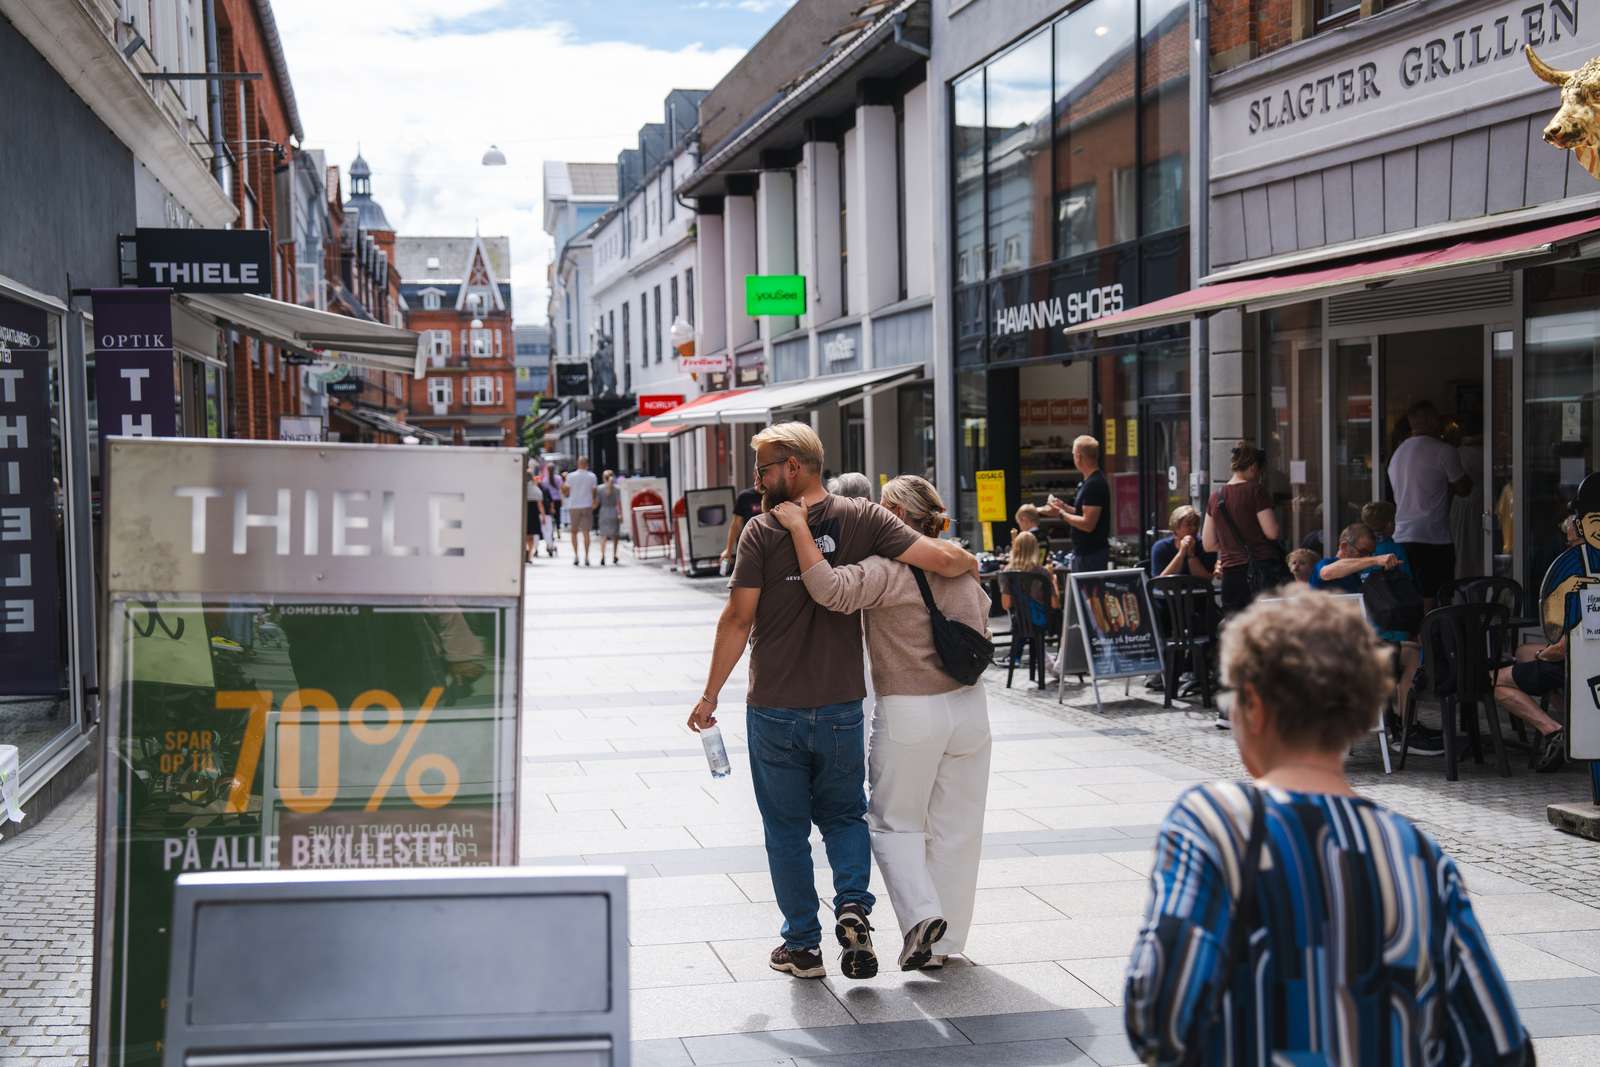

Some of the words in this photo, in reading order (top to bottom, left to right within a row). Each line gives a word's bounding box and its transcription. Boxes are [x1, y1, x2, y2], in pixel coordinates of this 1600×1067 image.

[1248, 61, 1381, 135] SLAGTER
[1400, 0, 1579, 89] GRILLEN
[149, 261, 259, 284] THIELE
[997, 298, 1064, 336] HAVANNA
[1067, 283, 1123, 324] SHOES
[102, 334, 165, 348] OPTIK
[1168, 465, 1178, 490] 9
[173, 486, 465, 557] THIELE
[279, 606, 359, 616] SOMMERSALG
[165, 731, 213, 751] SPAR
[215, 686, 461, 814] 70%
[160, 754, 184, 773] OP
[164, 828, 201, 871] PÅ
[211, 835, 280, 870] ALLE
[291, 830, 461, 869] BRILLESTEL
